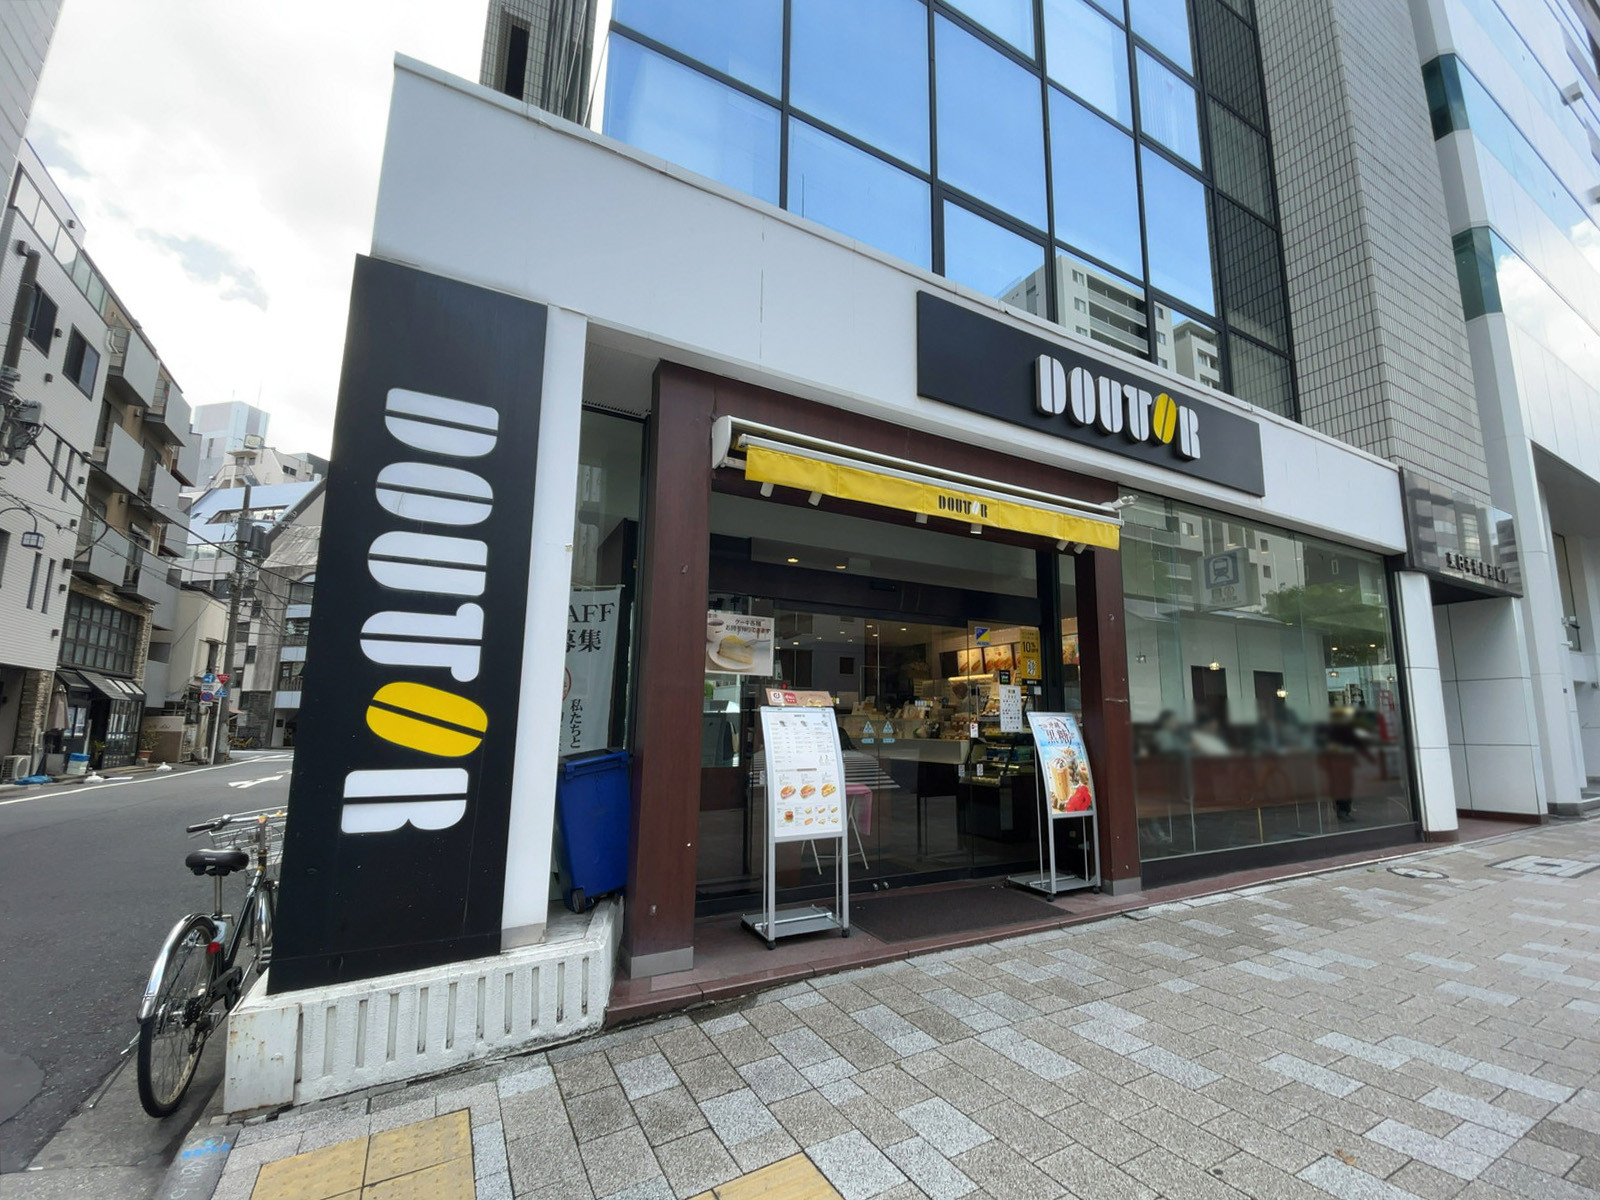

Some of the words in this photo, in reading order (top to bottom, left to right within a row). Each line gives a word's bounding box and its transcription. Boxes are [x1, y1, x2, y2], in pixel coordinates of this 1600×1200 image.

[1037, 354, 1201, 459] DOUTOR
[938, 494, 988, 519] DOUTOR
[341, 387, 500, 834] DOUTOR
